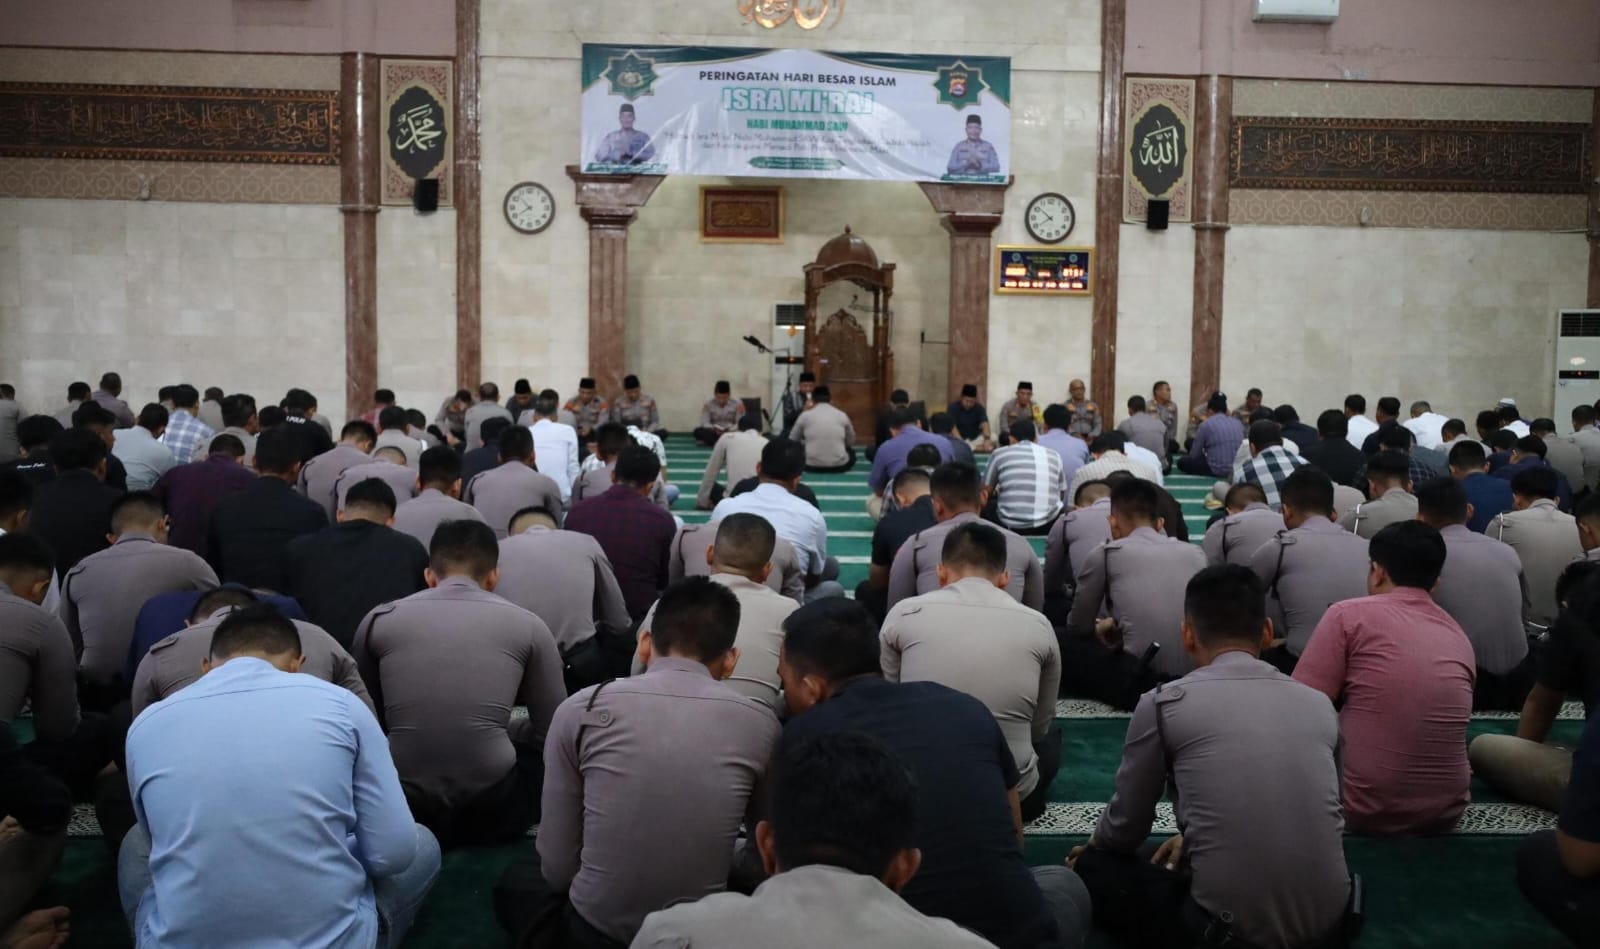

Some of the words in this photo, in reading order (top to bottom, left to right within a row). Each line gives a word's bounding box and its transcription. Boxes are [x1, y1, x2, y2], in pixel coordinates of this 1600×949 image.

[699, 70, 780, 81] PERINGATAN
[783, 72, 814, 83] HARI
[817, 74, 856, 85] BESAR
[859, 76, 897, 87] ISLAM
[721, 87, 785, 112] ISRA
[770, 119, 825, 131] MUHAMMAD
